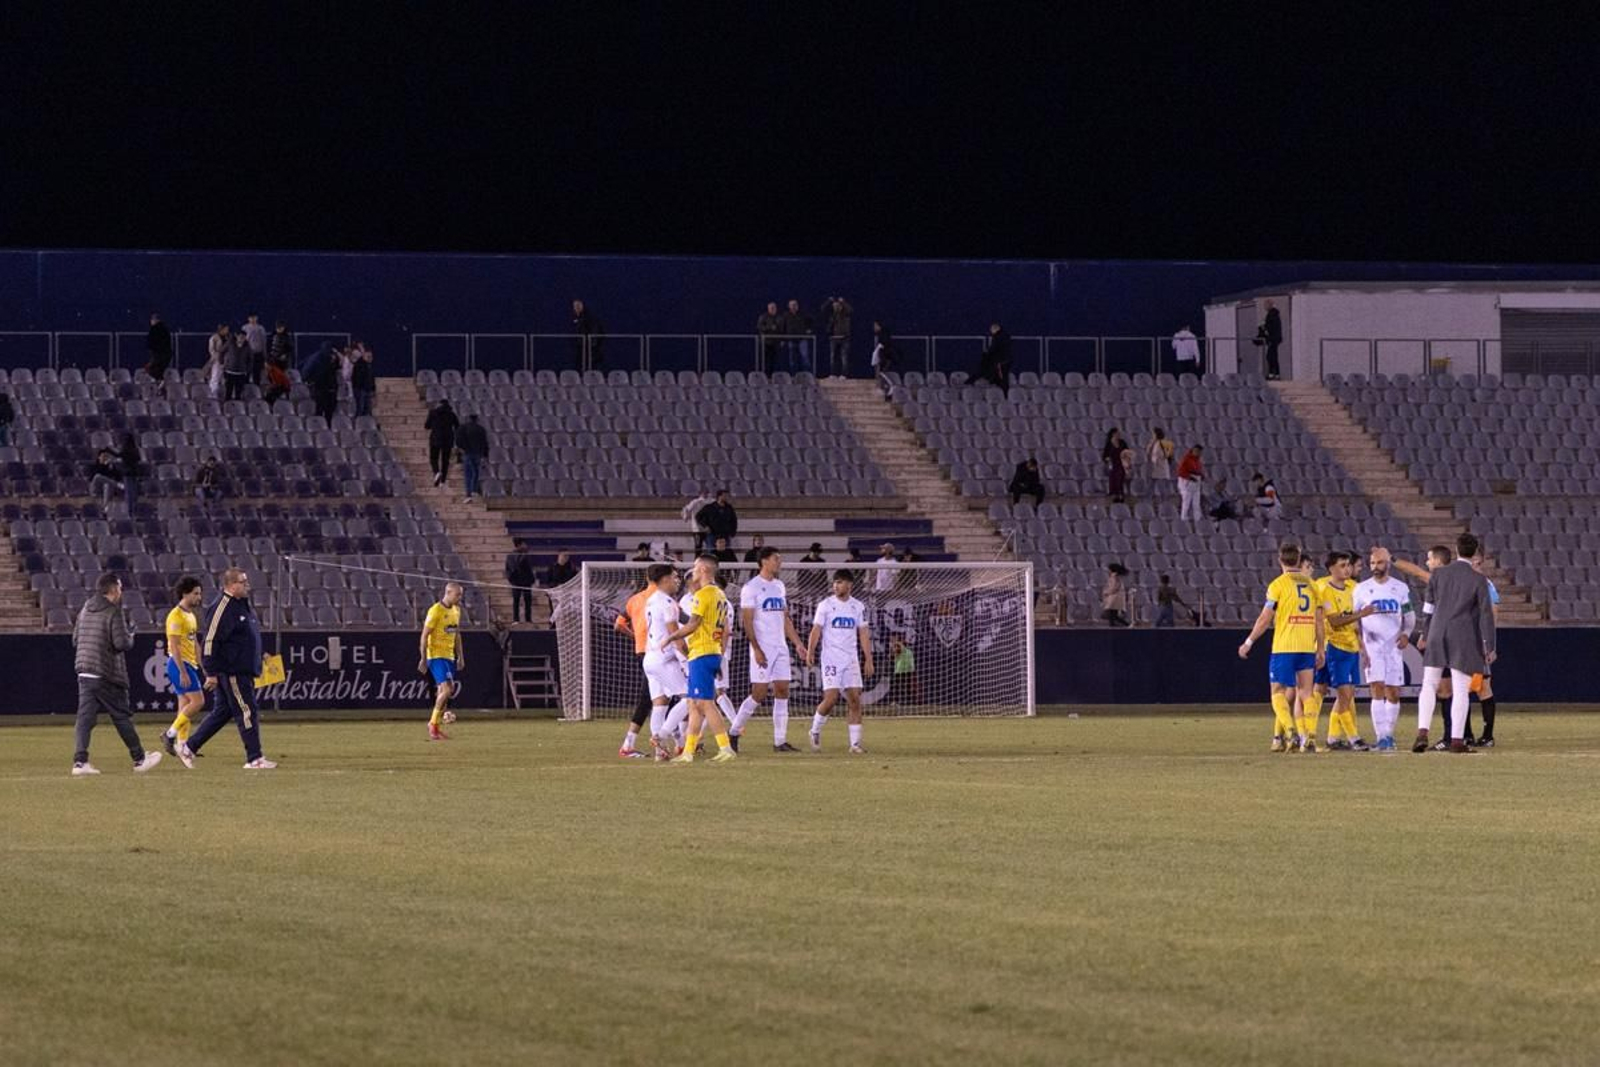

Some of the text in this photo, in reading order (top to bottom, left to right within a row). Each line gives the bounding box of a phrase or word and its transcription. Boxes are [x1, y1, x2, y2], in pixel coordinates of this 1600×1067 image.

[1296, 583, 1310, 613] 5
[255, 669, 372, 700] ndestable
[824, 665, 837, 677] 23
